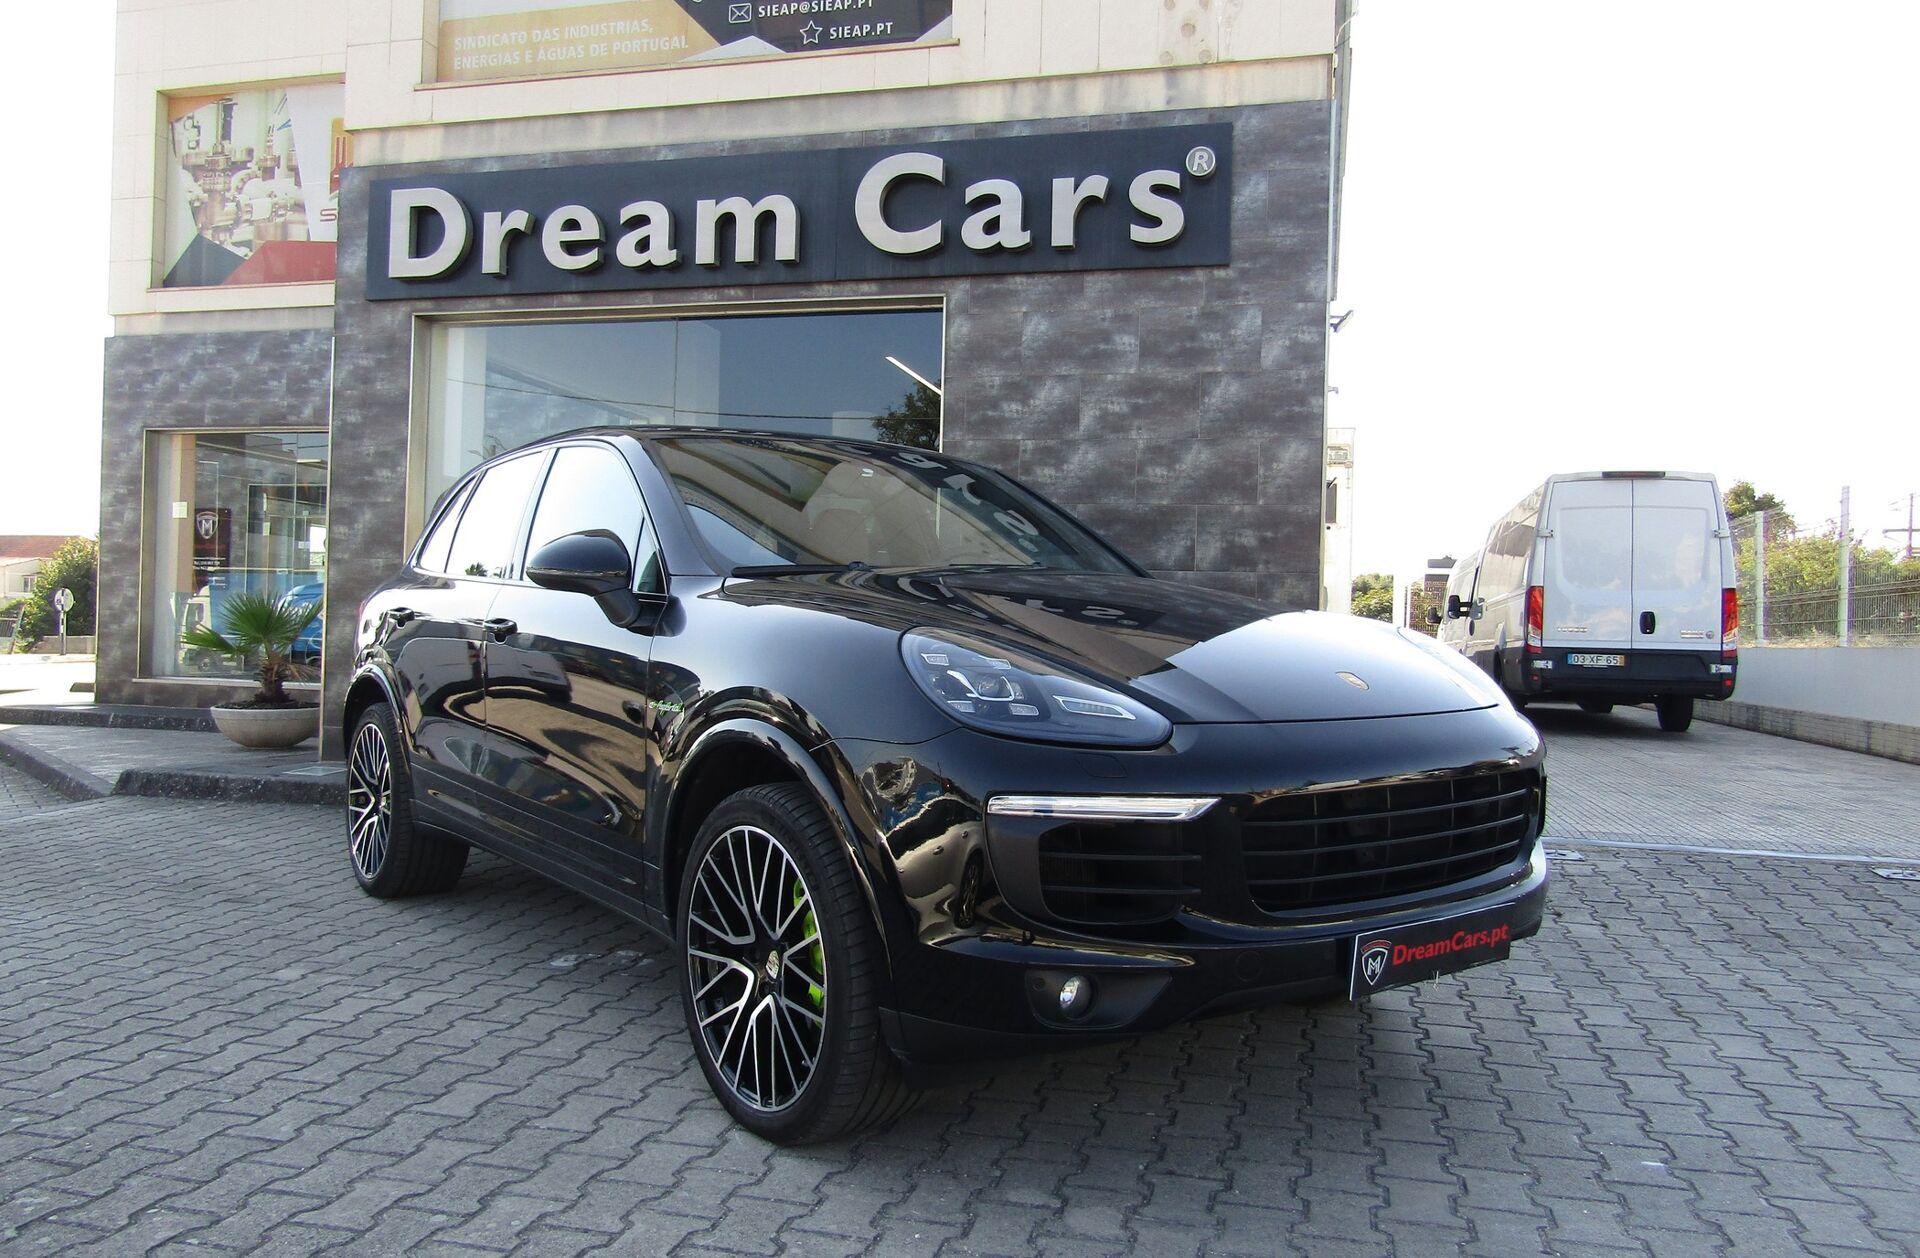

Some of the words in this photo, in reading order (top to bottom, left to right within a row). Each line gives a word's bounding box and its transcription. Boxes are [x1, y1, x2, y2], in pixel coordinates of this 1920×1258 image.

[454, 31, 528, 50] SINDICATO
[532, 27, 560, 43] DAS
[829, 21, 894, 40] SIEAP.PT
[454, 50, 520, 70] ENERGIAS
[525, 49, 533, 64] E
[590, 42, 609, 57] DE
[388, 187, 800, 279] Dream
[1392, 924, 1509, 965] DreamCars.pt
